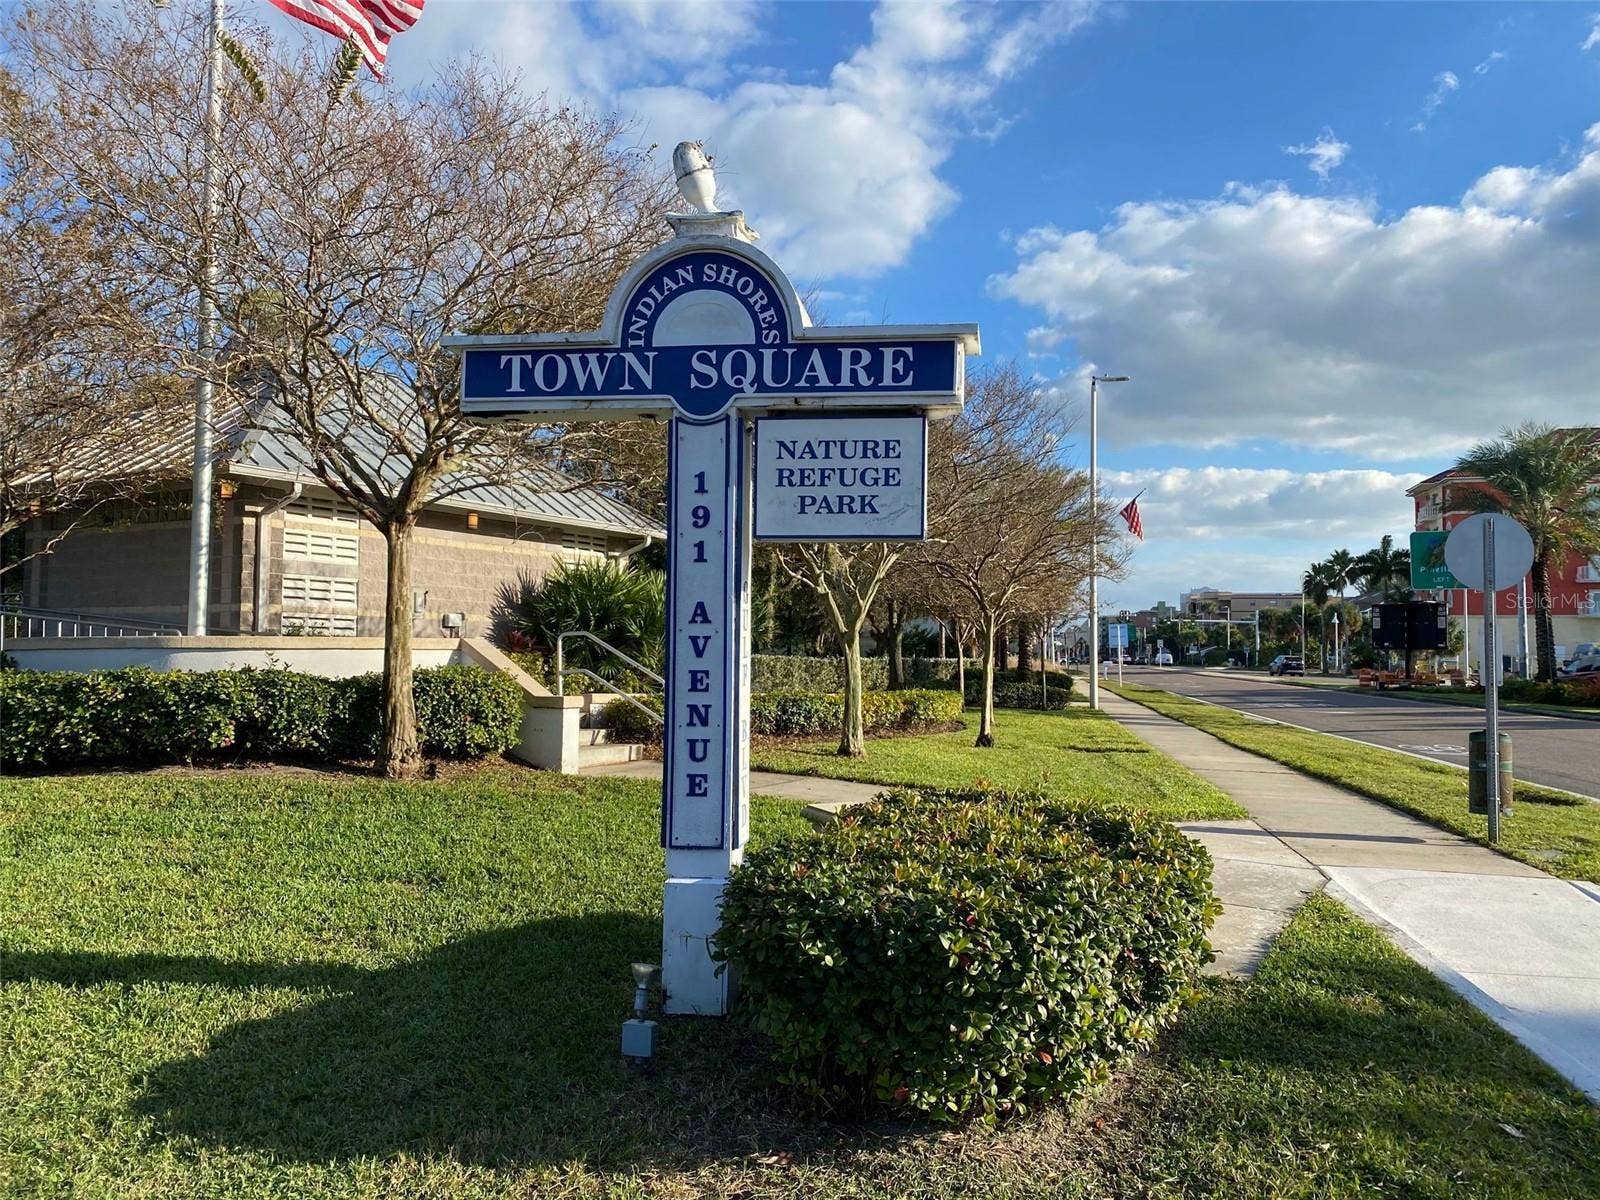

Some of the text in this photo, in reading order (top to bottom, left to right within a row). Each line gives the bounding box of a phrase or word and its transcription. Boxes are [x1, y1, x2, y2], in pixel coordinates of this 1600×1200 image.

[628, 263, 781, 348] INDIAN SHORES
[500, 346, 913, 394] TOWN SQUARE
[775, 439, 902, 460] NATURE
[775, 467, 902, 488] REFUGE
[797, 494, 880, 515] PARK
[686, 471, 712, 797] 191 AVENUE
